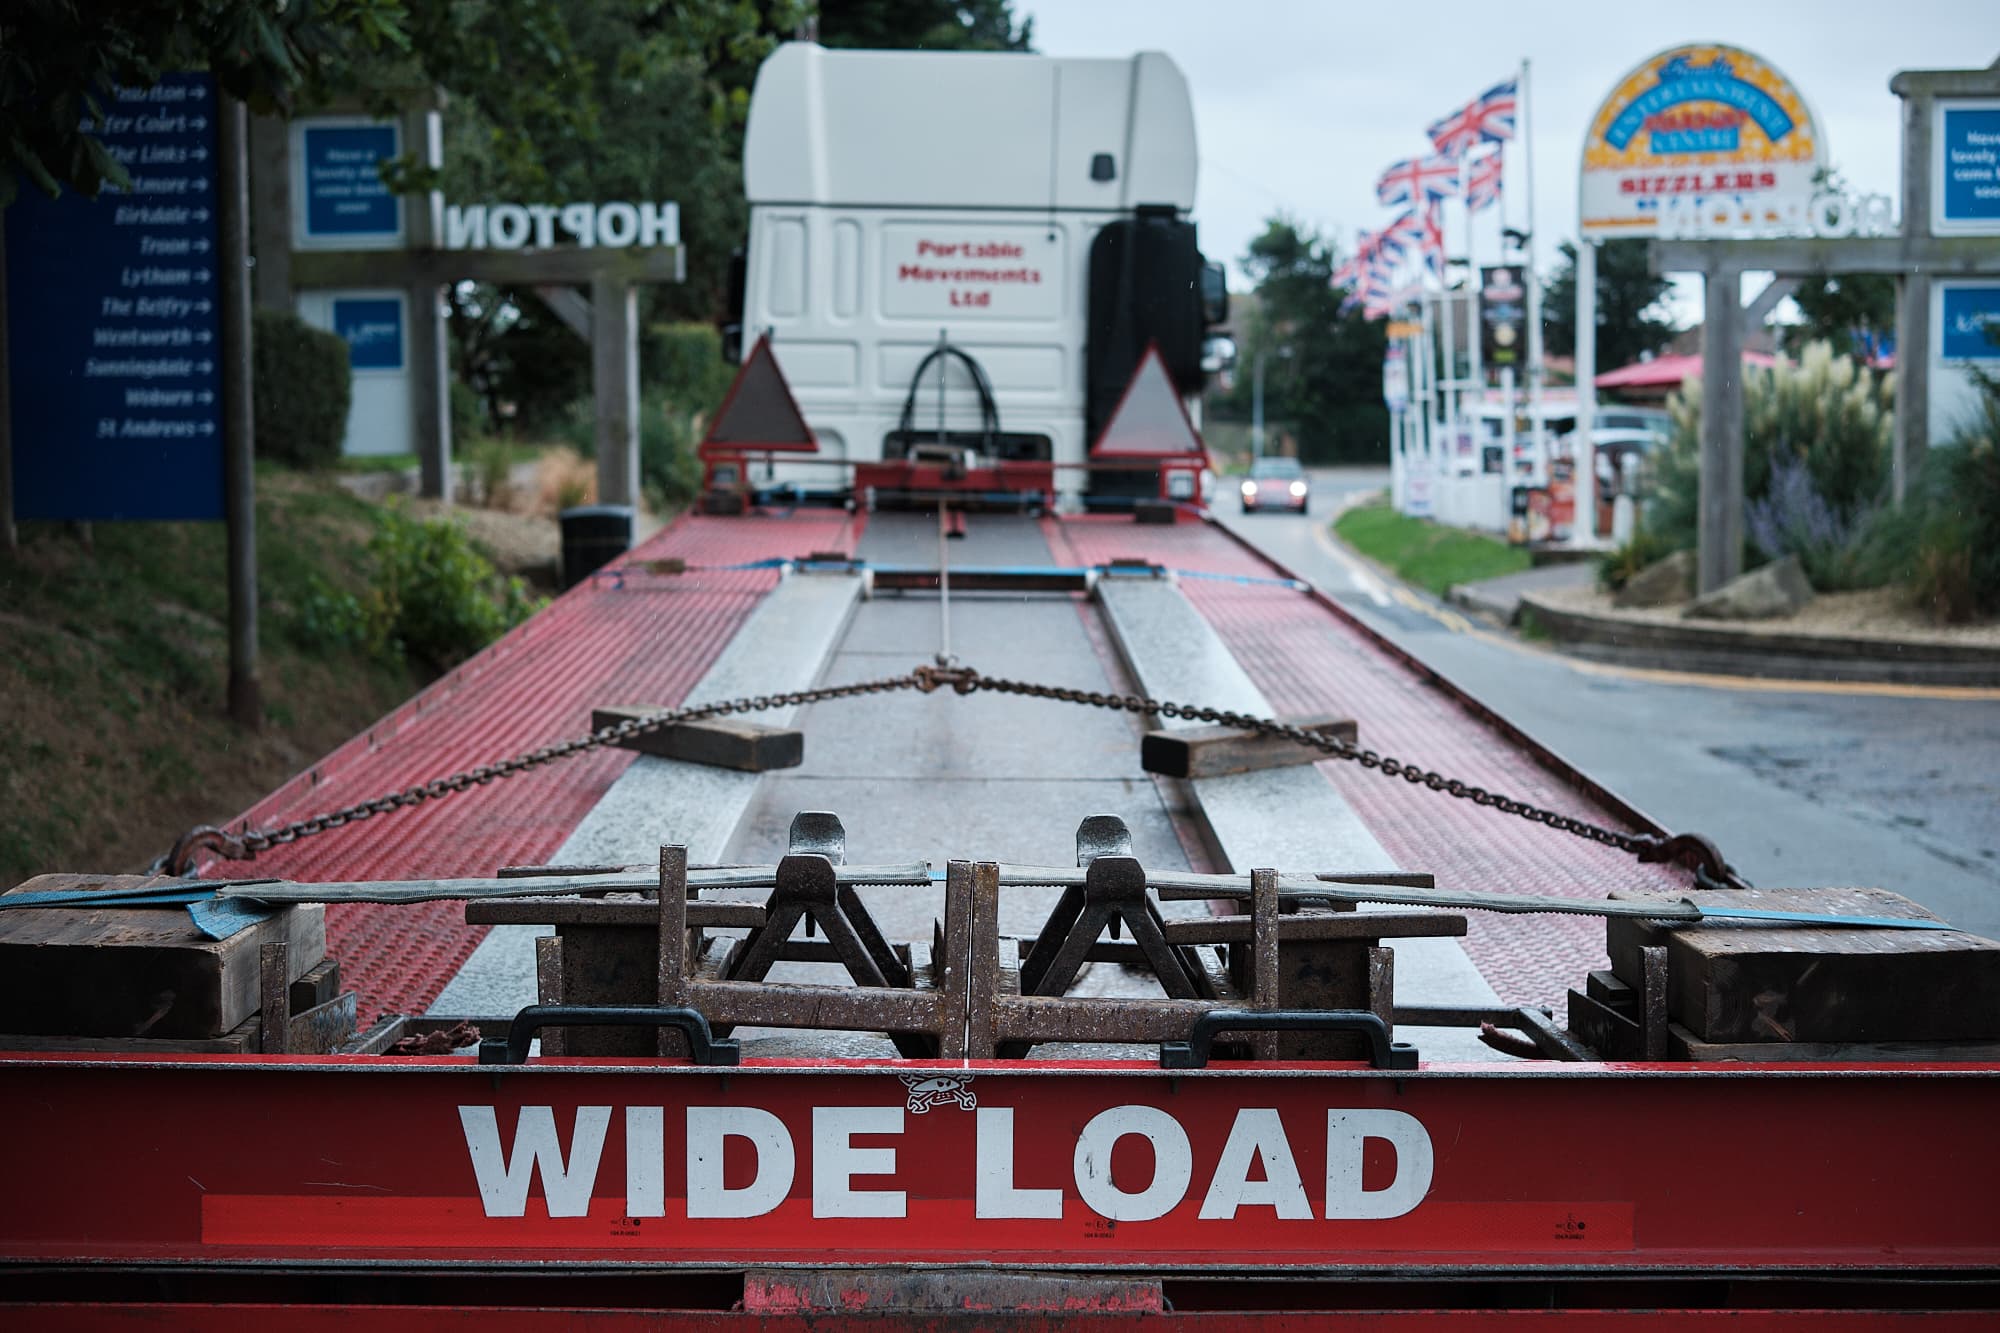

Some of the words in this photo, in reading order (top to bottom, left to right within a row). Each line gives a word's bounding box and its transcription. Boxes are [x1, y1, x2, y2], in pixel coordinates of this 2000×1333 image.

[1620, 171, 1777, 195] SIZZLERS
[141, 235, 190, 256] Troon
[916, 240, 1023, 258] Portable
[121, 266, 191, 288] Lytham
[898, 264, 1041, 284] Movements
[102, 297, 131, 317] The
[135, 297, 190, 318] Belfry
[949, 289, 991, 308] Ltd
[93, 327, 192, 347] Wentworth
[120, 417, 196, 438] Andrews
[457, 1104, 907, 1219] WIDE
[975, 1104, 1435, 1222] LOAD
